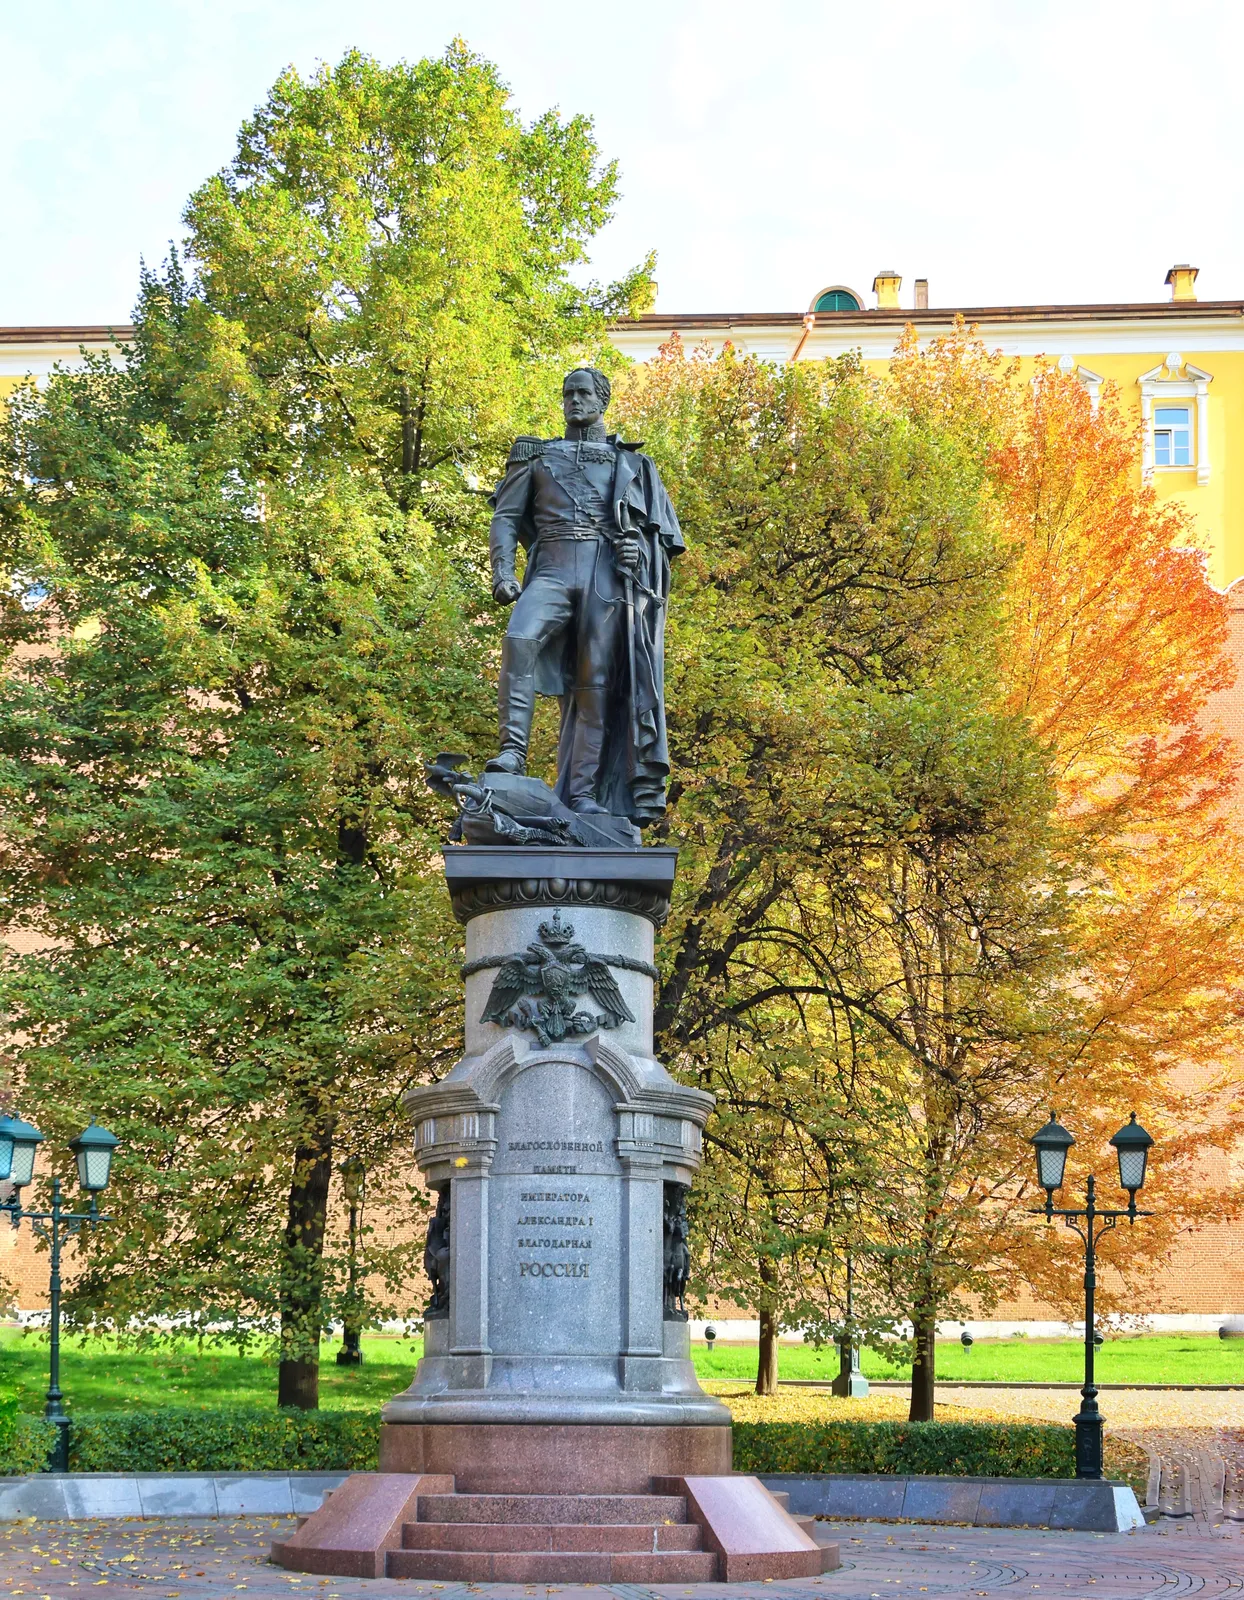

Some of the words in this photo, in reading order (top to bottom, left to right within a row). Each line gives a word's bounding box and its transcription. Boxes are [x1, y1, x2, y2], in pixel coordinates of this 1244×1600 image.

[508, 1140, 604, 1152] БЛАГОСЛОВЕННОЙ
[533, 1165, 577, 1174] ПАМЯТИ
[520, 1192, 591, 1202] ИМПЕРАТОРА
[517, 1216, 586, 1226] АЛЕКСАНДРА
[517, 1239, 592, 1249] БЛАГОДАРНАЯ
[520, 1262, 590, 1278] РОССИЯ
